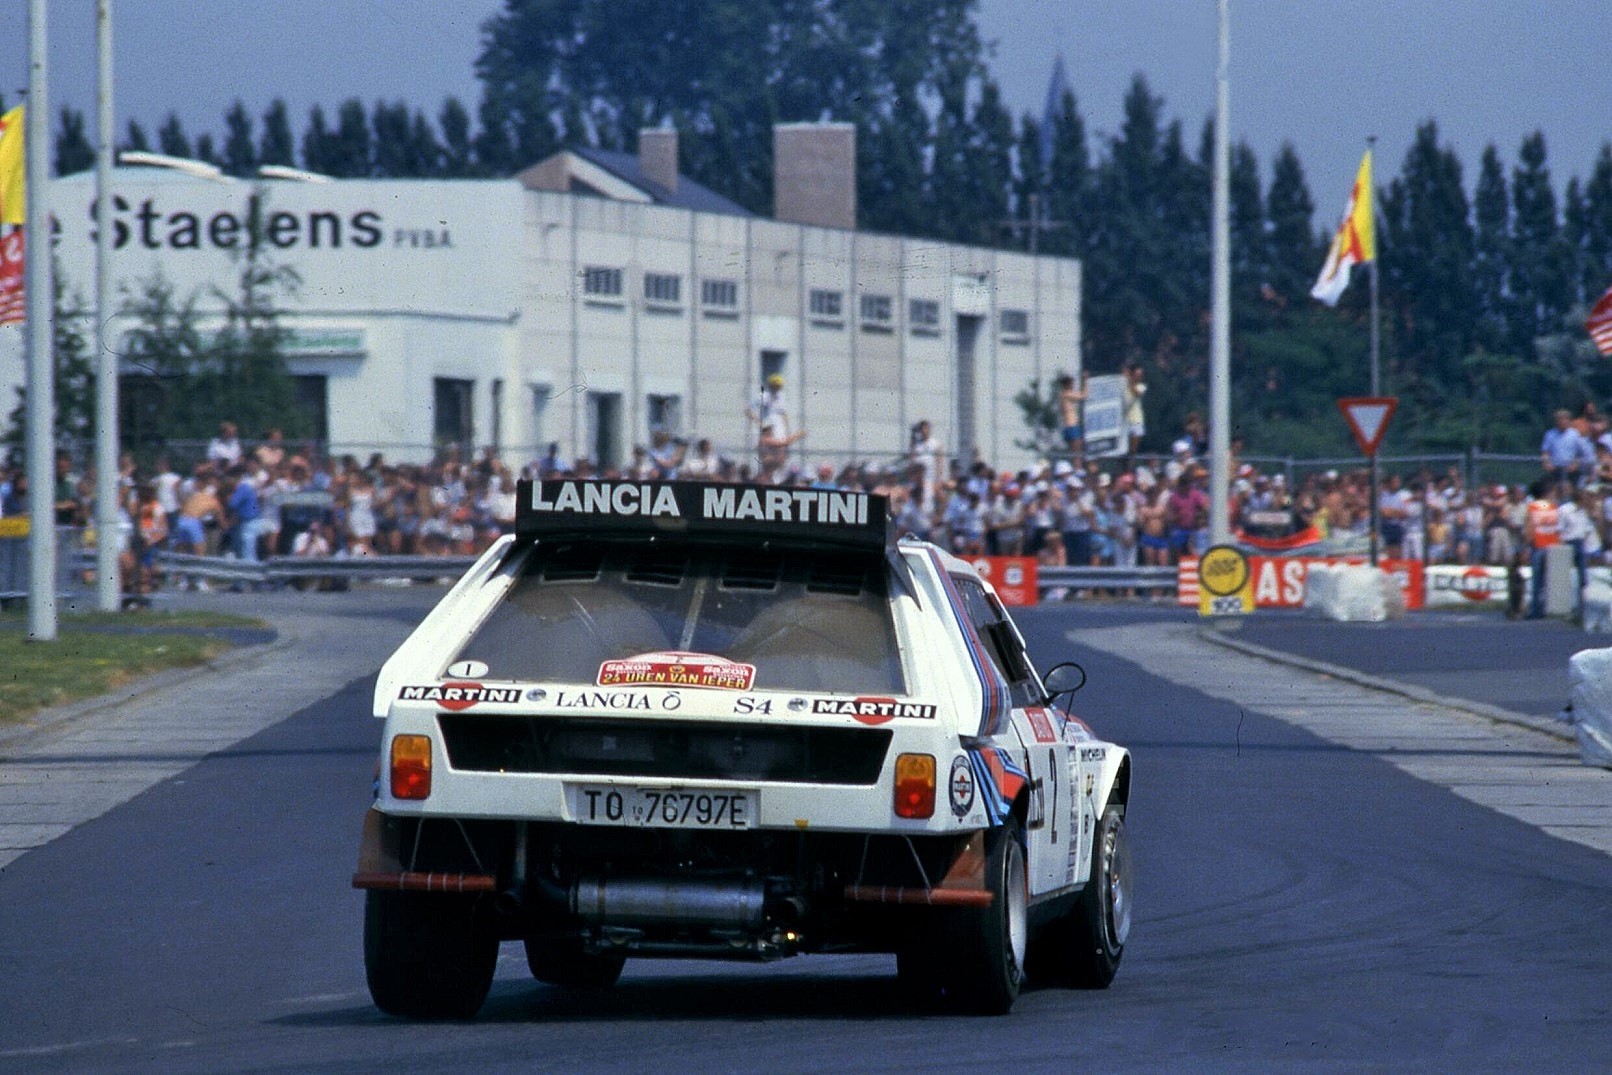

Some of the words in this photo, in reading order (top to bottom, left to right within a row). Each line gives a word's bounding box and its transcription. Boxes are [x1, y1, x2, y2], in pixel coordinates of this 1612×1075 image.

[531, 480, 681, 517] LANCIA
[703, 488, 868, 525] MARTINI
[603, 673, 620, 683] 24
[626, 672, 666, 682] UREN
[671, 673, 698, 684] VAN
[703, 675, 745, 688] IEPER
[402, 687, 518, 703] MARTINI
[556, 692, 651, 709] LANCIA
[733, 697, 773, 715] S4
[816, 700, 933, 718] MARTINI
[645, 793, 746, 825] 76797E
